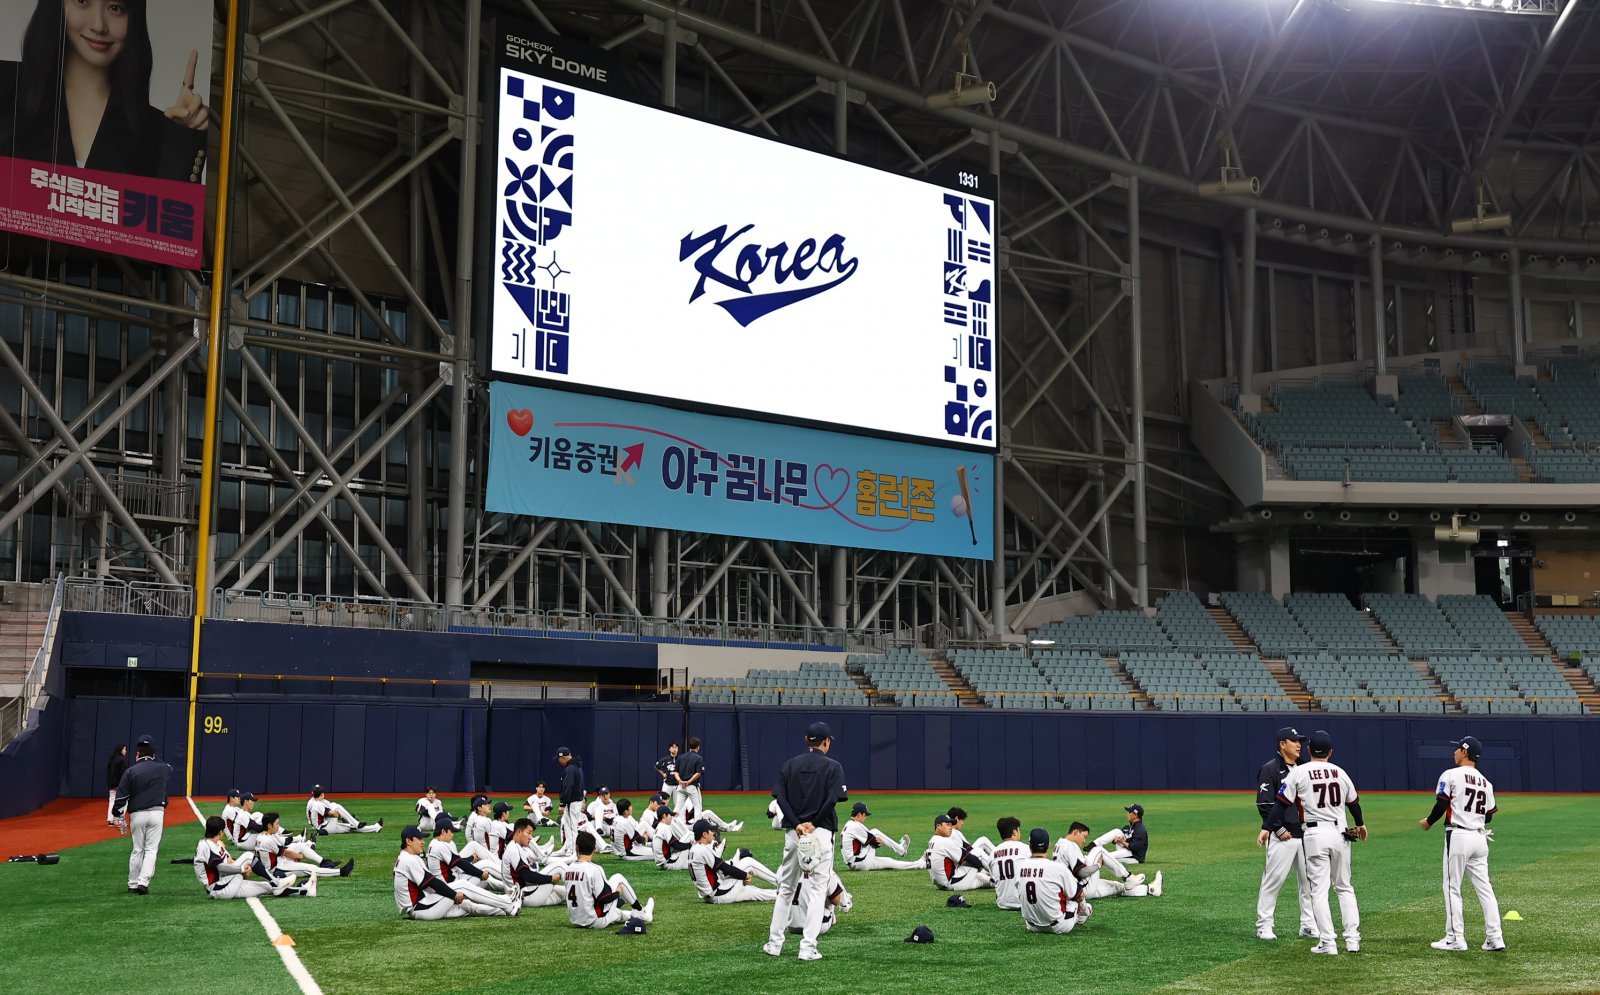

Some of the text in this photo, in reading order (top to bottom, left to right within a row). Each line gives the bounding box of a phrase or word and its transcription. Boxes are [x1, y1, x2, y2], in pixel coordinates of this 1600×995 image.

[506, 34, 554, 53] GOCHEOK
[505, 43, 608, 83] SKY DOME
[30, 167, 120, 206] 주식투자는
[47, 192, 119, 225] 시작부터
[121, 188, 195, 242] 키움
[679, 223, 858, 304] Korea
[529, 436, 618, 476] 키움증권
[856, 469, 935, 522] 홈런존
[1308, 768, 1339, 781] LEE D W
[1464, 774, 1476, 786] KIM
[1312, 782, 1342, 809] 70
[1463, 787, 1487, 815] 72
[997, 858, 1015, 881] 10
[1032, 867, 1038, 878] S
[1038, 867, 1044, 878] H
[567, 884, 579, 908] 4
[1025, 880, 1038, 905] 8
